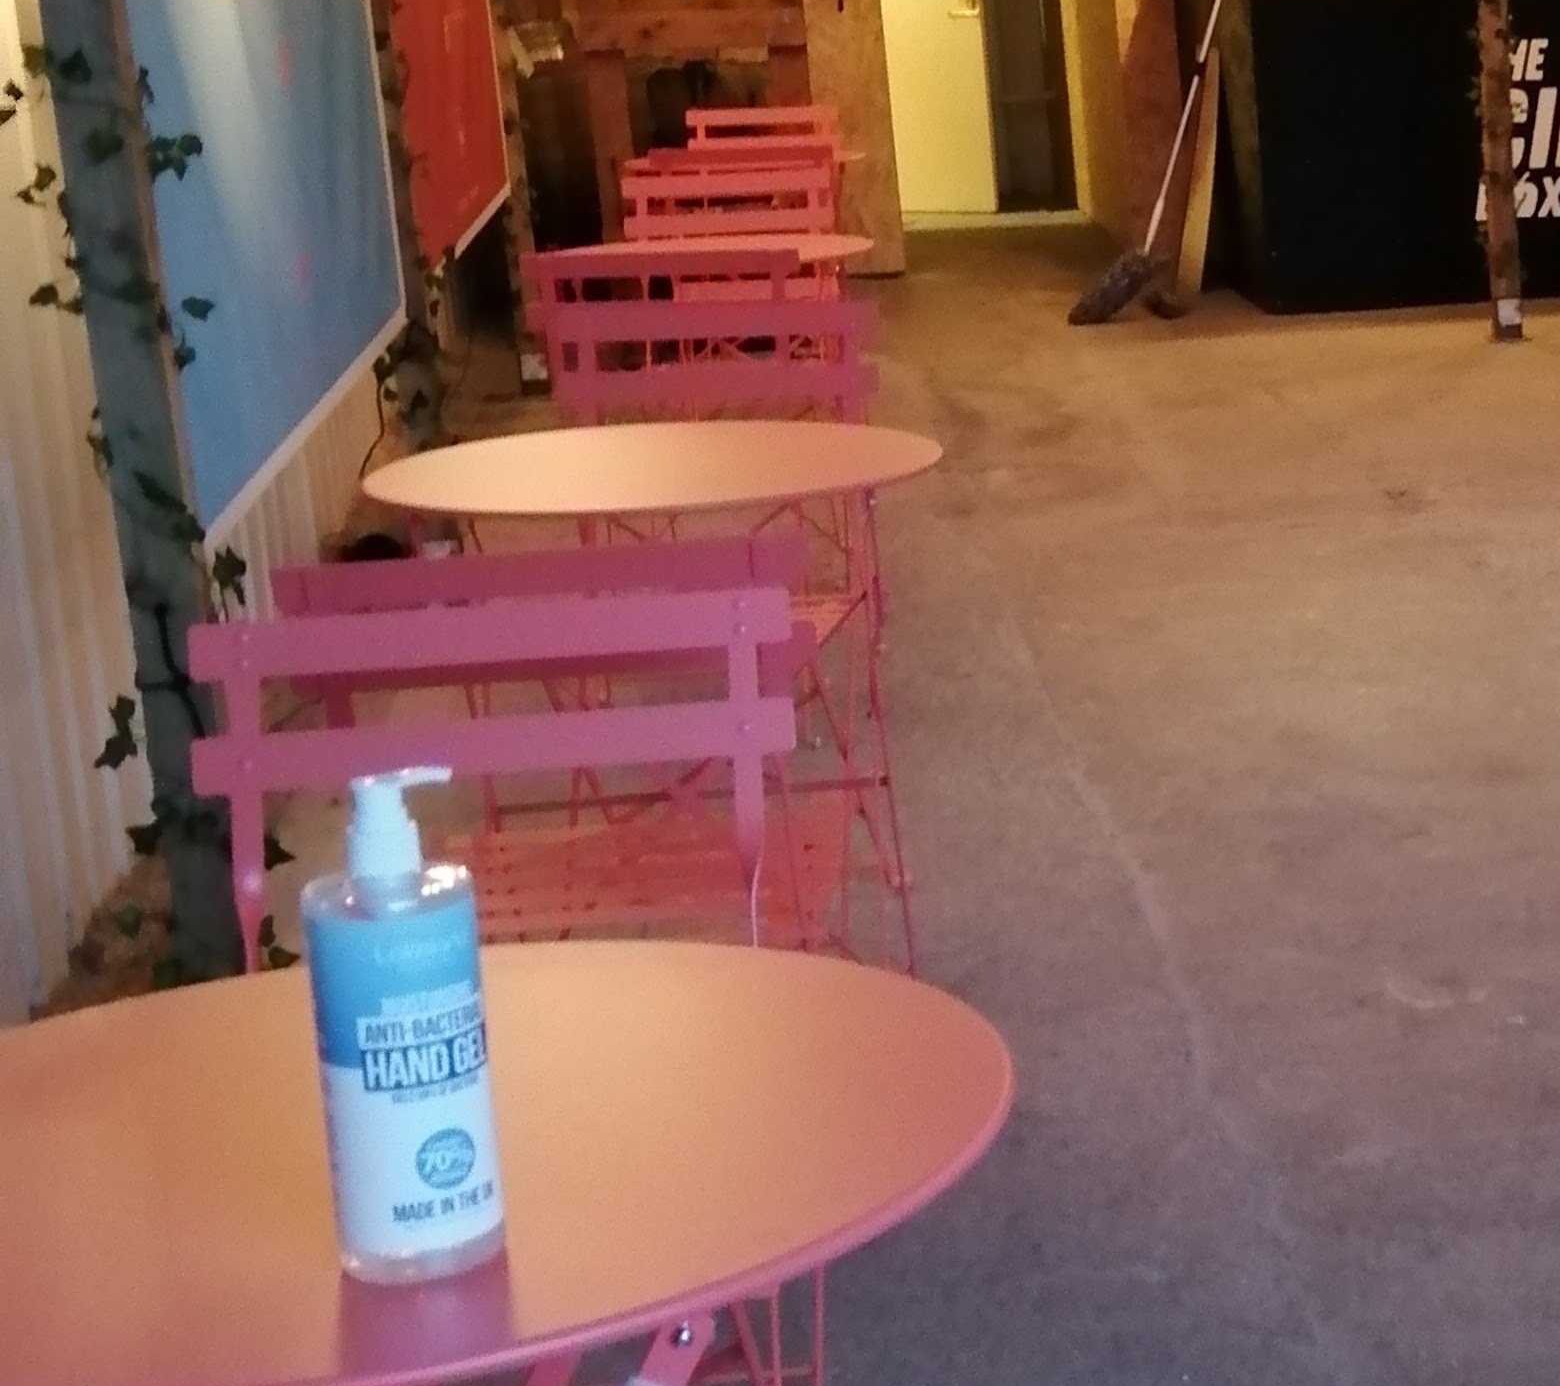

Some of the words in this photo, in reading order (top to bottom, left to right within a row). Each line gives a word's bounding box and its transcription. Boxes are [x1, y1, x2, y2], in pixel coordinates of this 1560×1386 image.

[1509, 38, 1549, 82] HE
[365, 1043, 450, 1088] HAND
[392, 1199, 435, 1222] MADE
[439, 1193, 455, 1215] IN
[457, 1182, 480, 1210] THE
